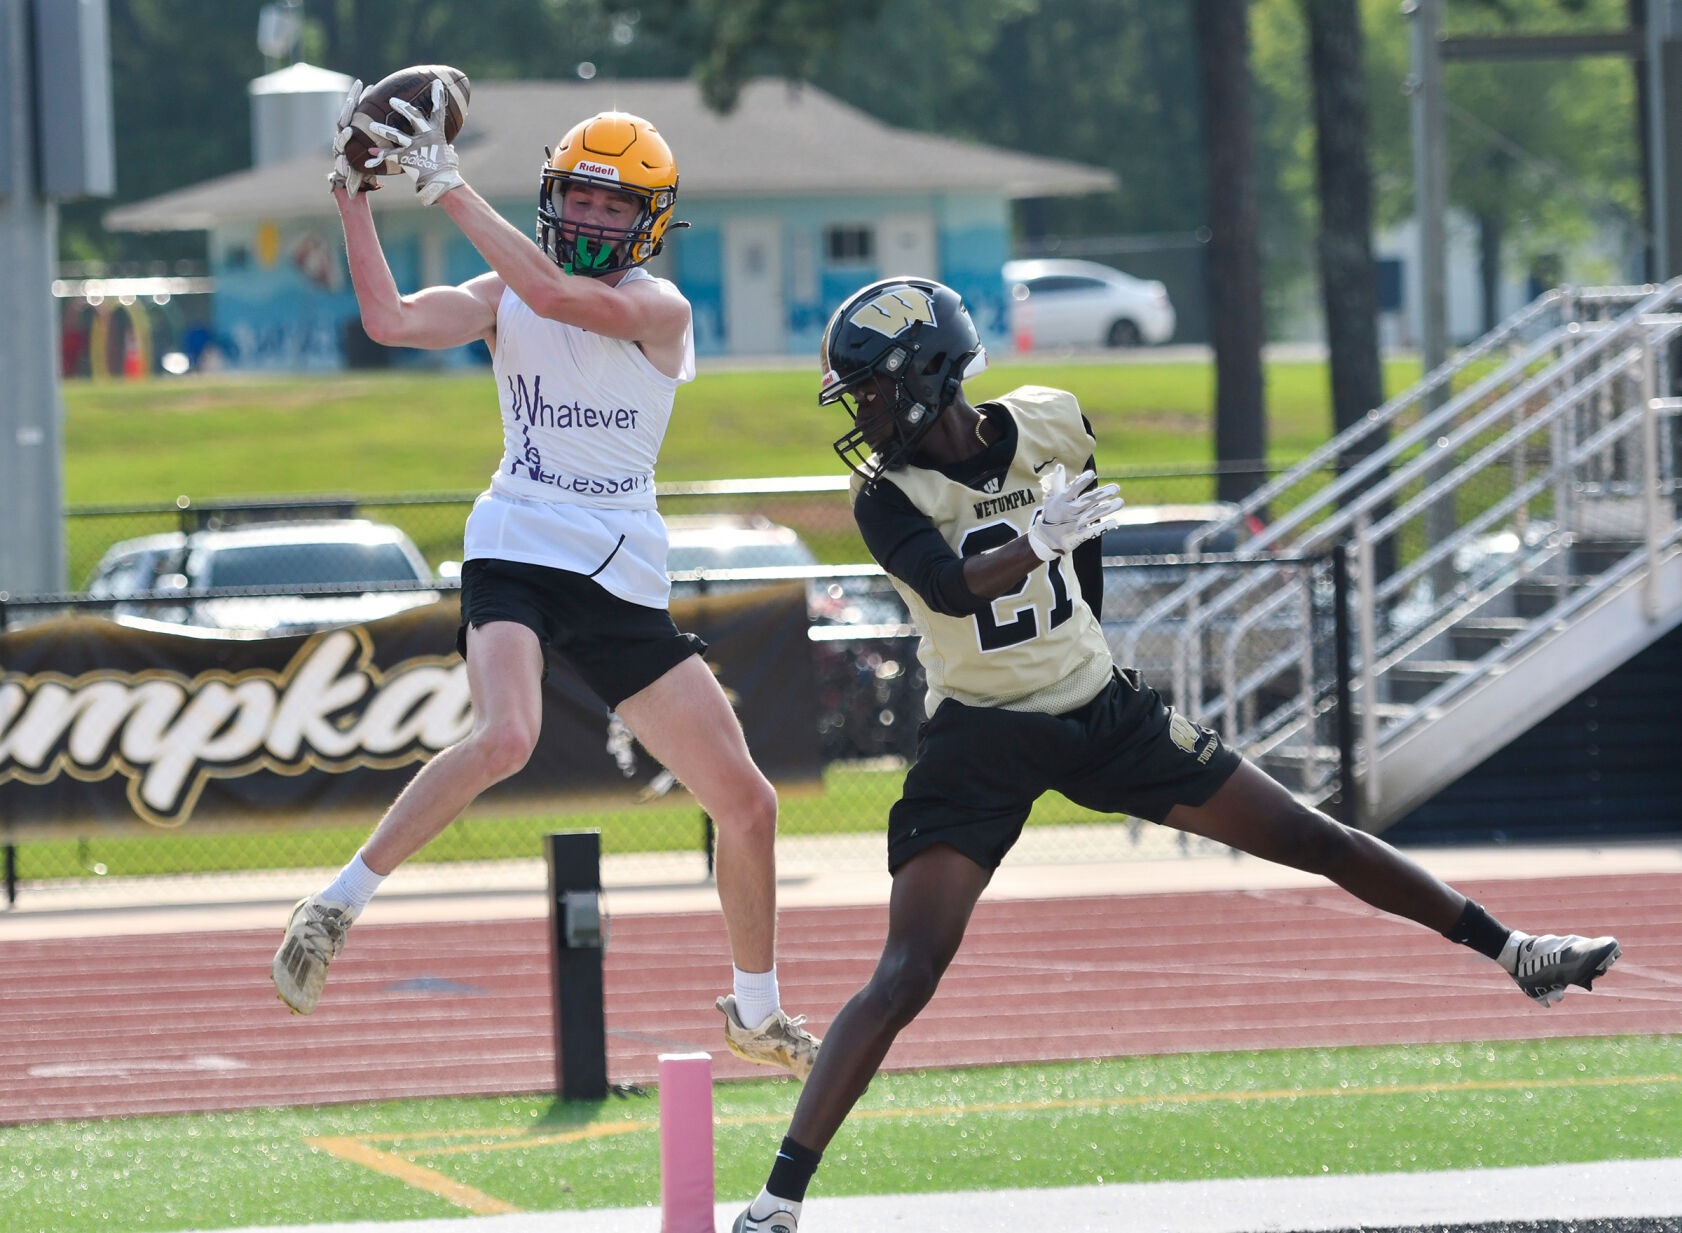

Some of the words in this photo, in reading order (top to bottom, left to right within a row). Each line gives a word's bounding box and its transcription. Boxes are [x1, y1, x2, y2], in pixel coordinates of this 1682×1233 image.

[400, 153, 439, 170] adidas
[579, 162, 615, 176] Riddell
[850, 284, 938, 339] W
[507, 374, 639, 430] Whatever
[973, 488, 1036, 520] WETUMPKA
[0, 630, 474, 811] mpka
